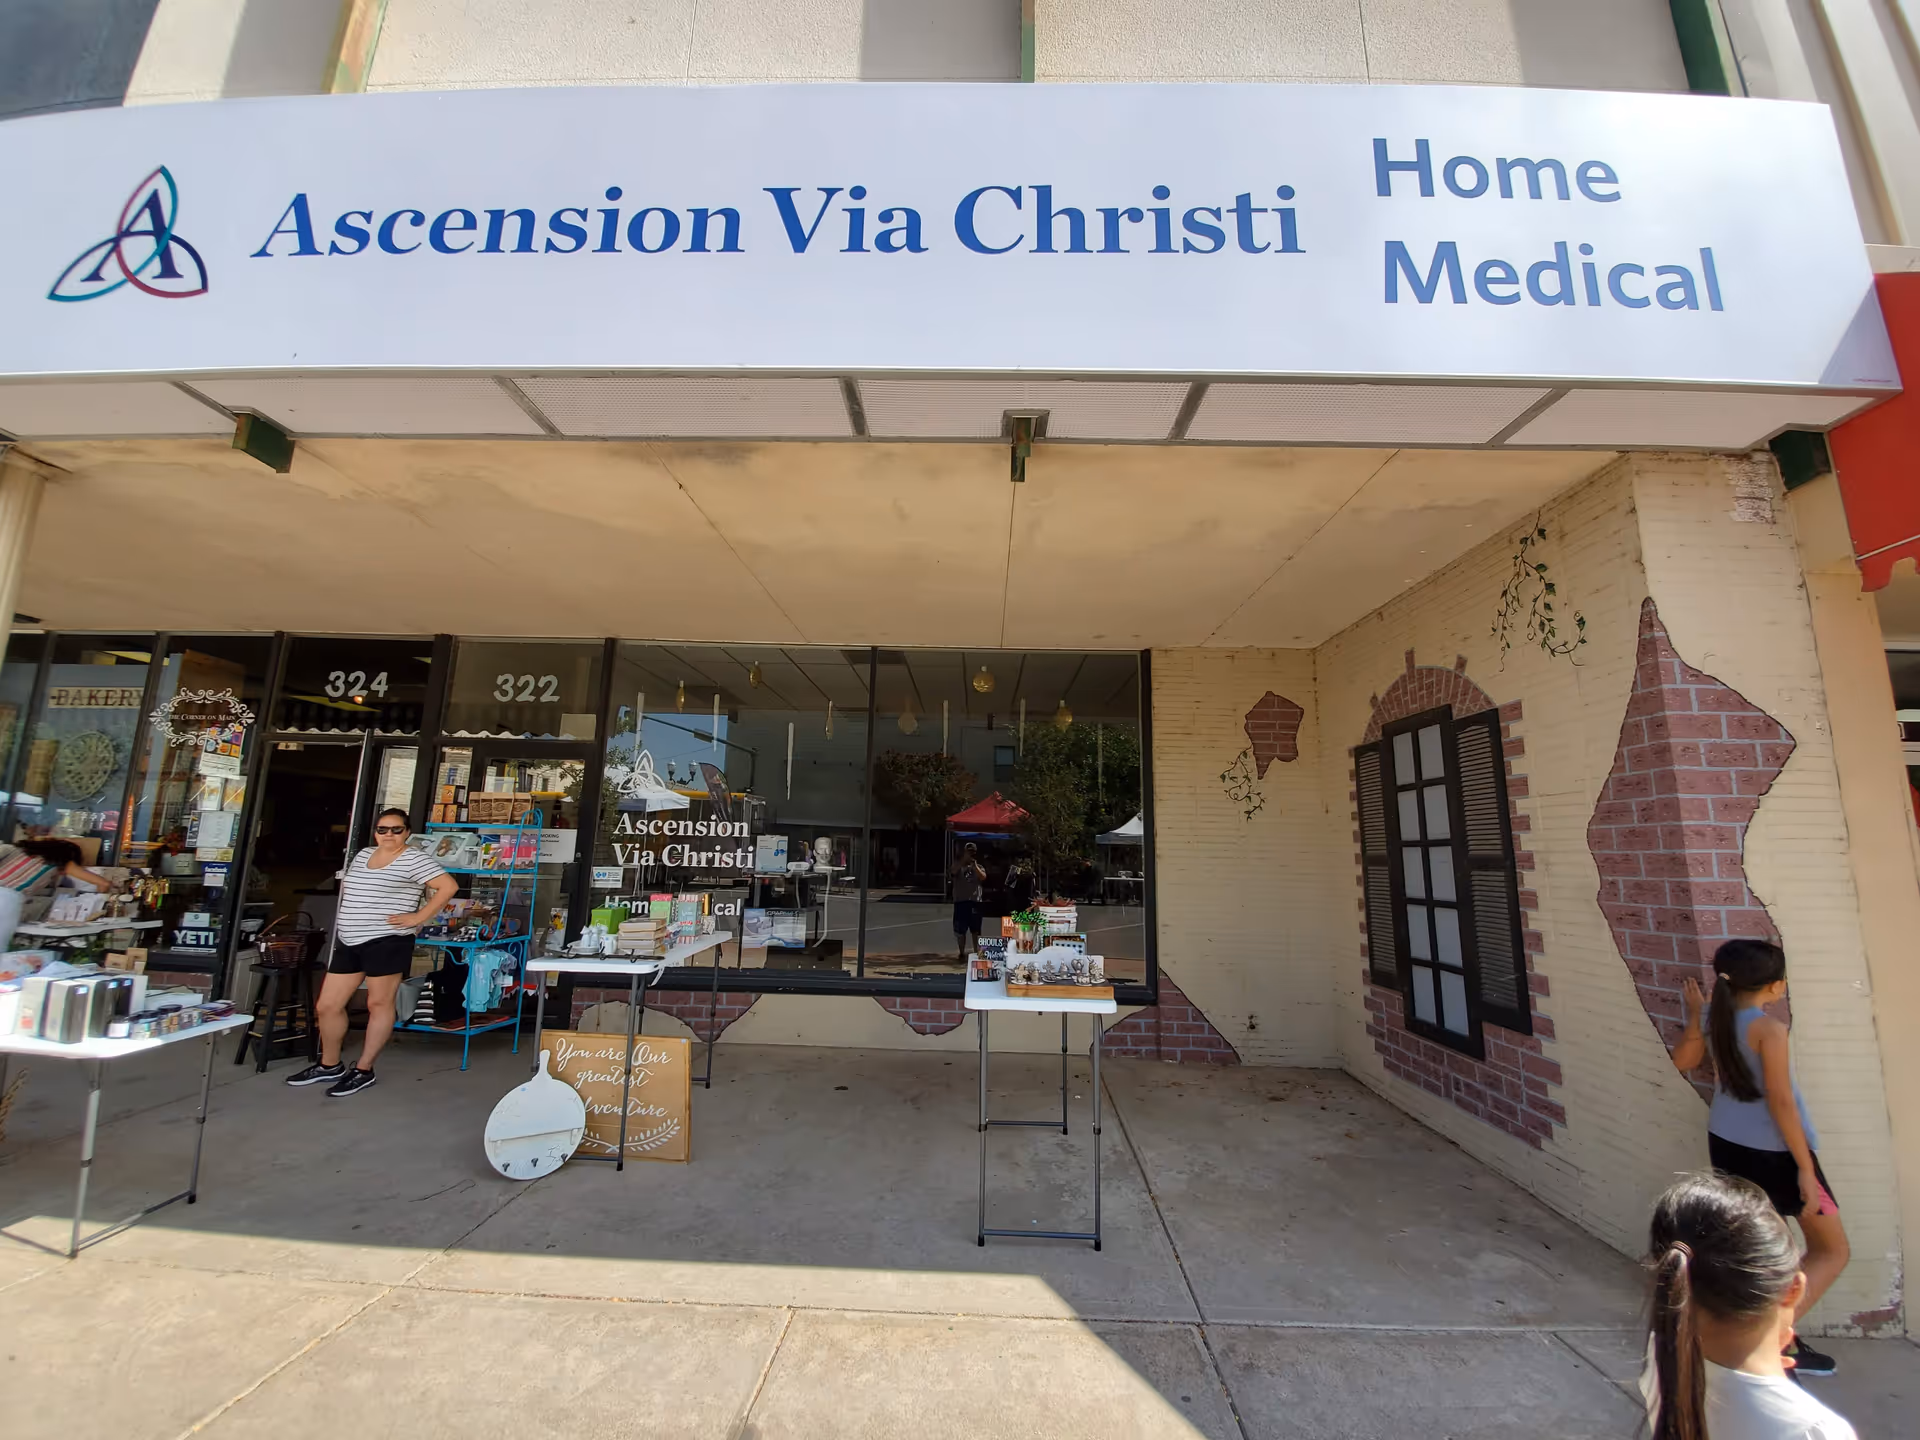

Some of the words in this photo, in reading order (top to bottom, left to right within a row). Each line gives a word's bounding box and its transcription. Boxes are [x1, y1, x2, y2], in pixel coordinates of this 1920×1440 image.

[1372, 137, 1622, 203] Home
[249, 185, 746, 258] Ascension
[762, 185, 926, 254] Via
[953, 185, 1306, 255] Christi
[1384, 240, 1724, 312] Medical
[324, 670, 389, 698] 324
[493, 673, 560, 703] 322
[613, 813, 750, 838] Ascension
[611, 843, 656, 867] Via
[662, 844, 755, 869] Christi
[604, 895, 649, 914] Hom
[174, 929, 215, 945] YETI
[978, 937, 1003, 947] GHOULS
[556, 1037, 592, 1072] You
[595, 1049, 626, 1062] are
[632, 1041, 673, 1067] Our
[584, 1096, 669, 1118] venture
